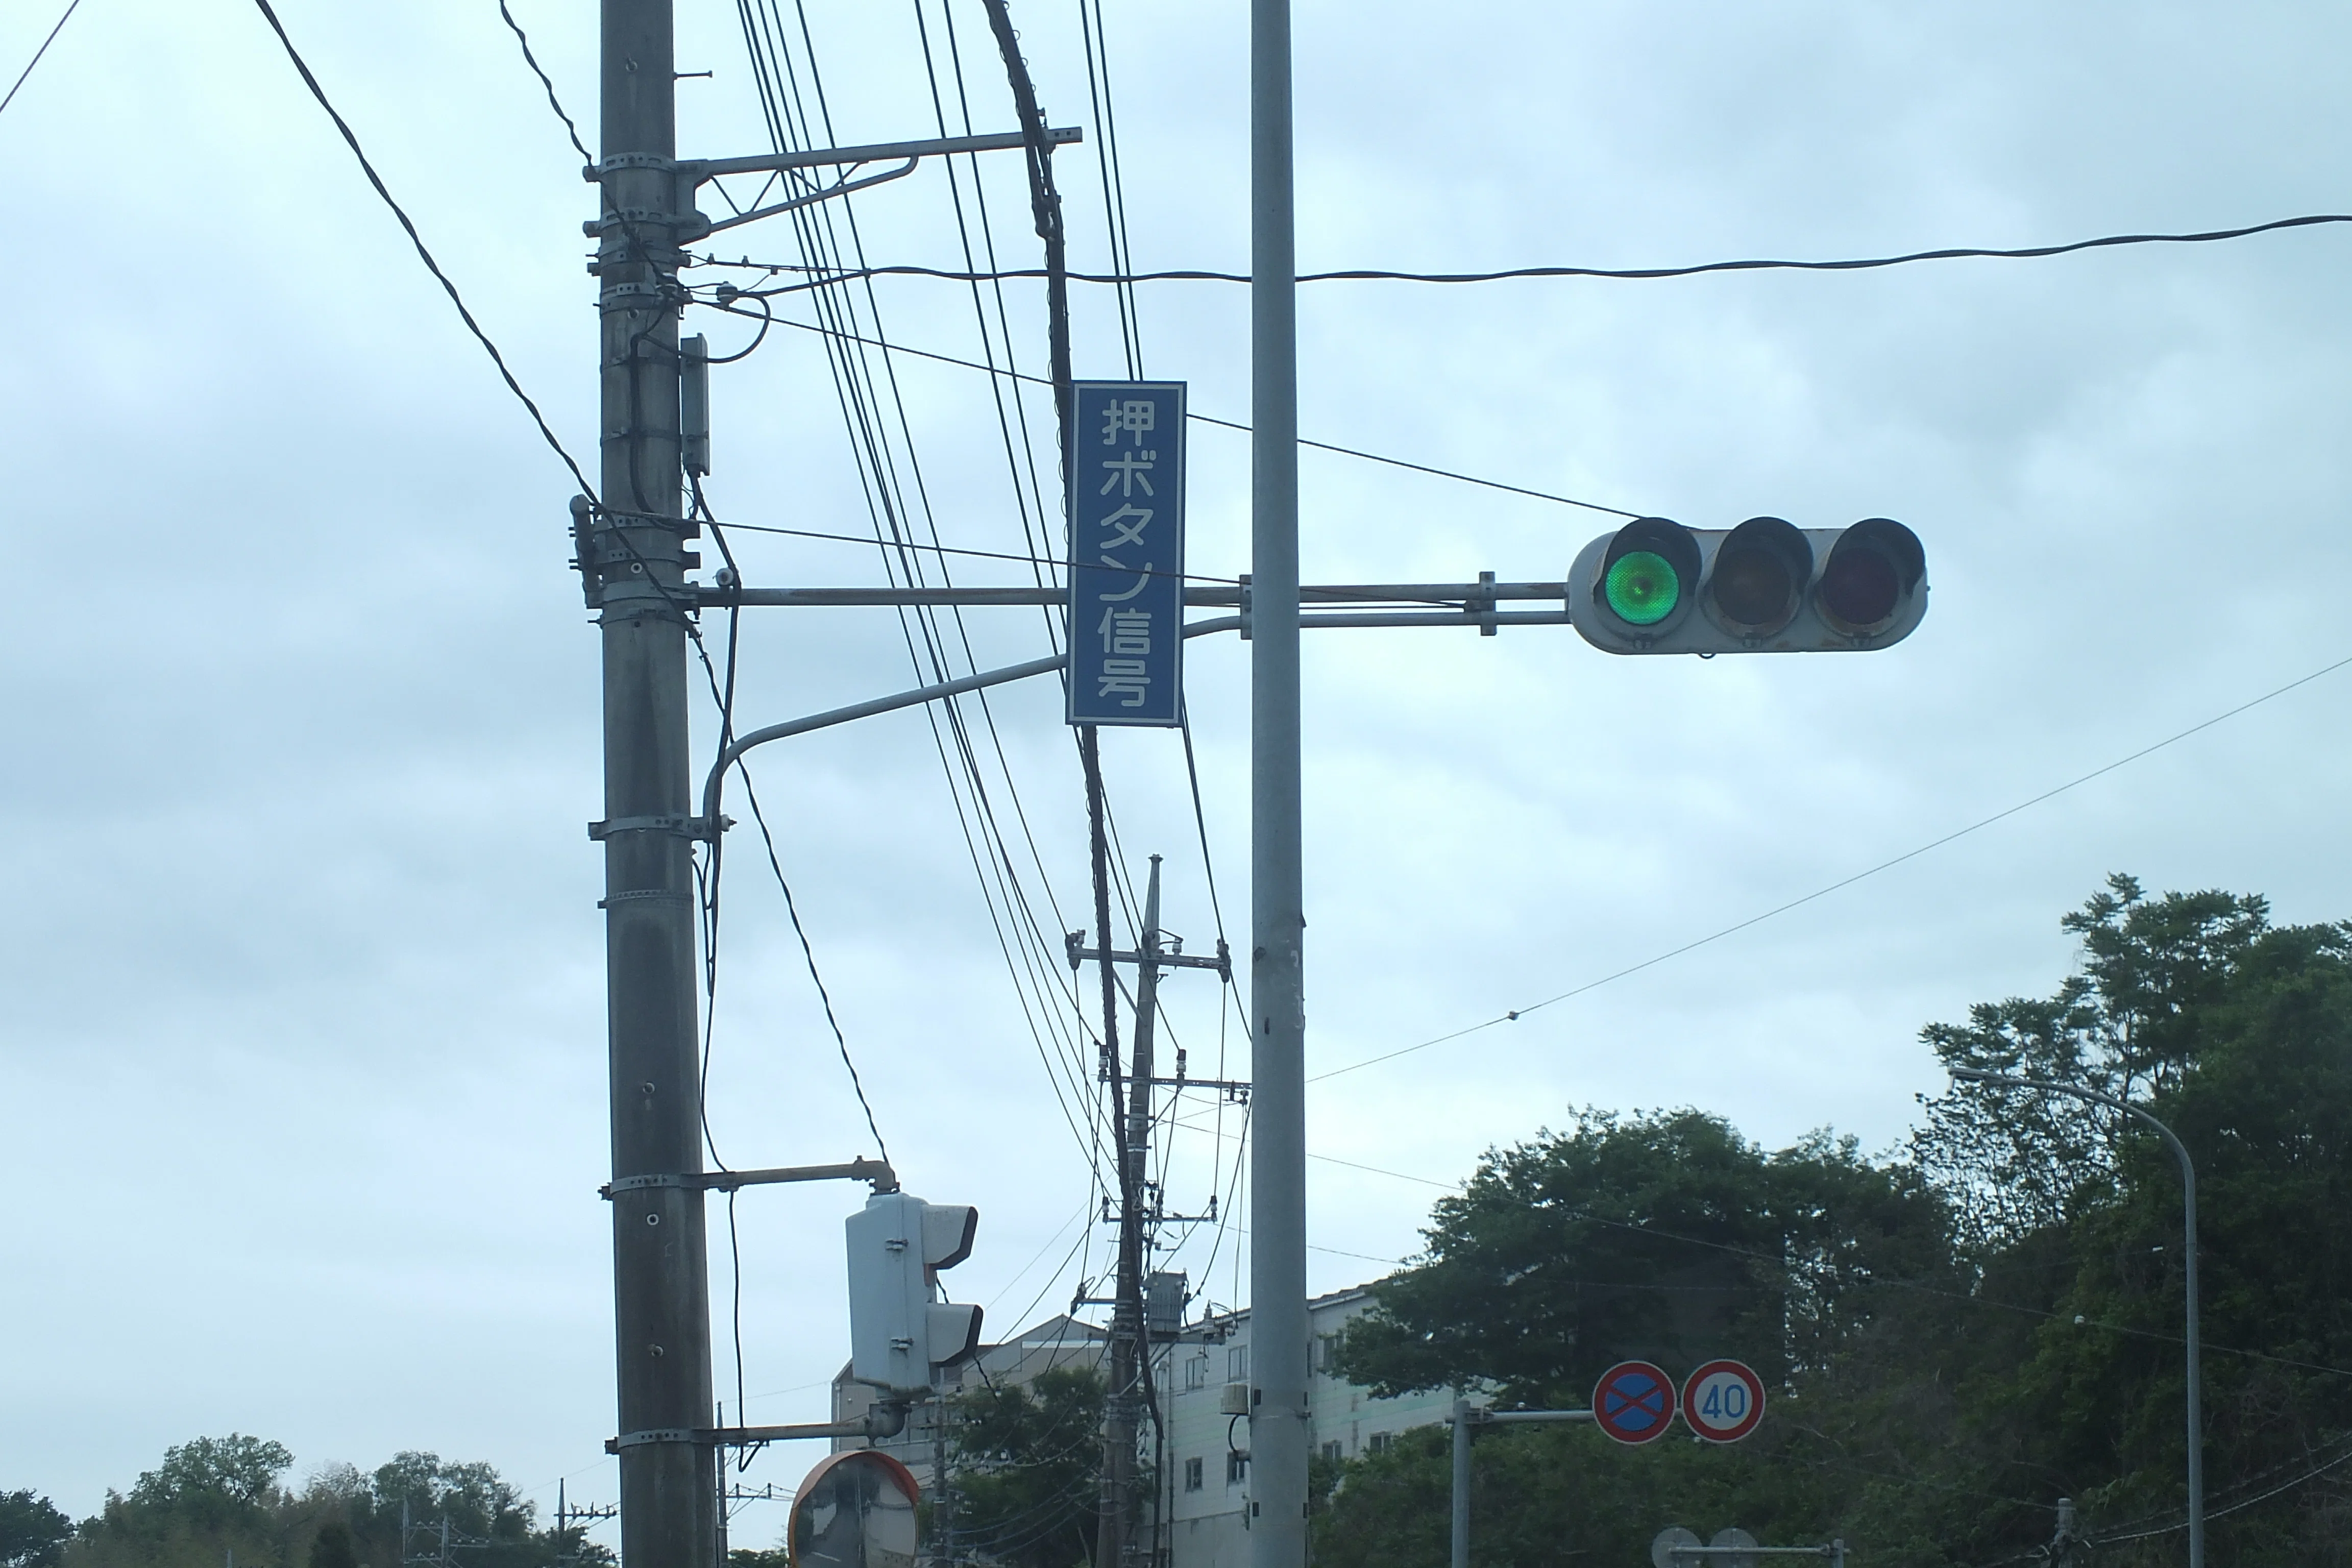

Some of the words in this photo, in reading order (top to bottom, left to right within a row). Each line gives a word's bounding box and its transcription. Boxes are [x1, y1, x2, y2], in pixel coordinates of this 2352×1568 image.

[1097, 399, 1157, 707] 押ボタン信号
[1701, 1384, 1746, 1418] 40
